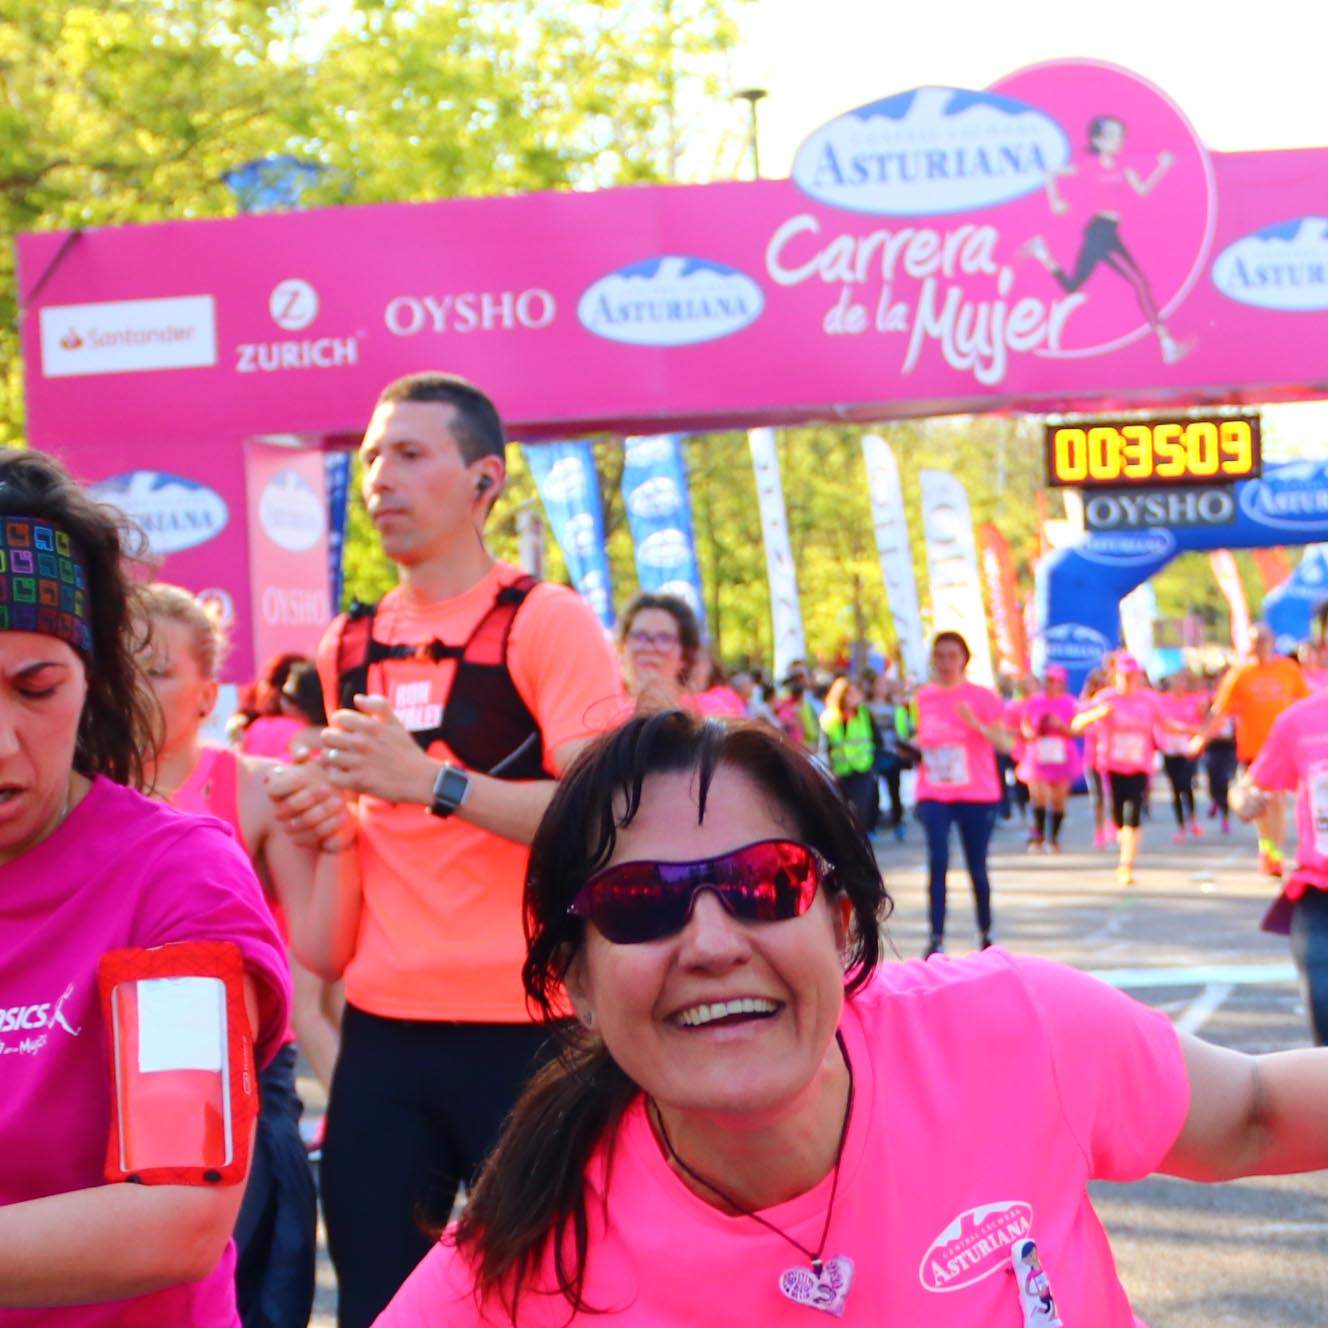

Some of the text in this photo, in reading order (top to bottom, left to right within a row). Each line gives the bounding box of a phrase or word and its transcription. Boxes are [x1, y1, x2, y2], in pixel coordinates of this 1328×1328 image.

[811, 138, 1048, 186] ASTURIANA
[765, 213, 1000, 286] Carrera
[384, 287, 557, 337] OYSHO
[592, 292, 749, 327] ASTURIANA
[822, 267, 1086, 386] de la Mujer
[86, 322, 195, 350] Santander
[234, 337, 360, 375] ZURICH
[1086, 489, 1235, 529] OYSHO
[930, 1215, 1032, 1287] ASTURIANA
